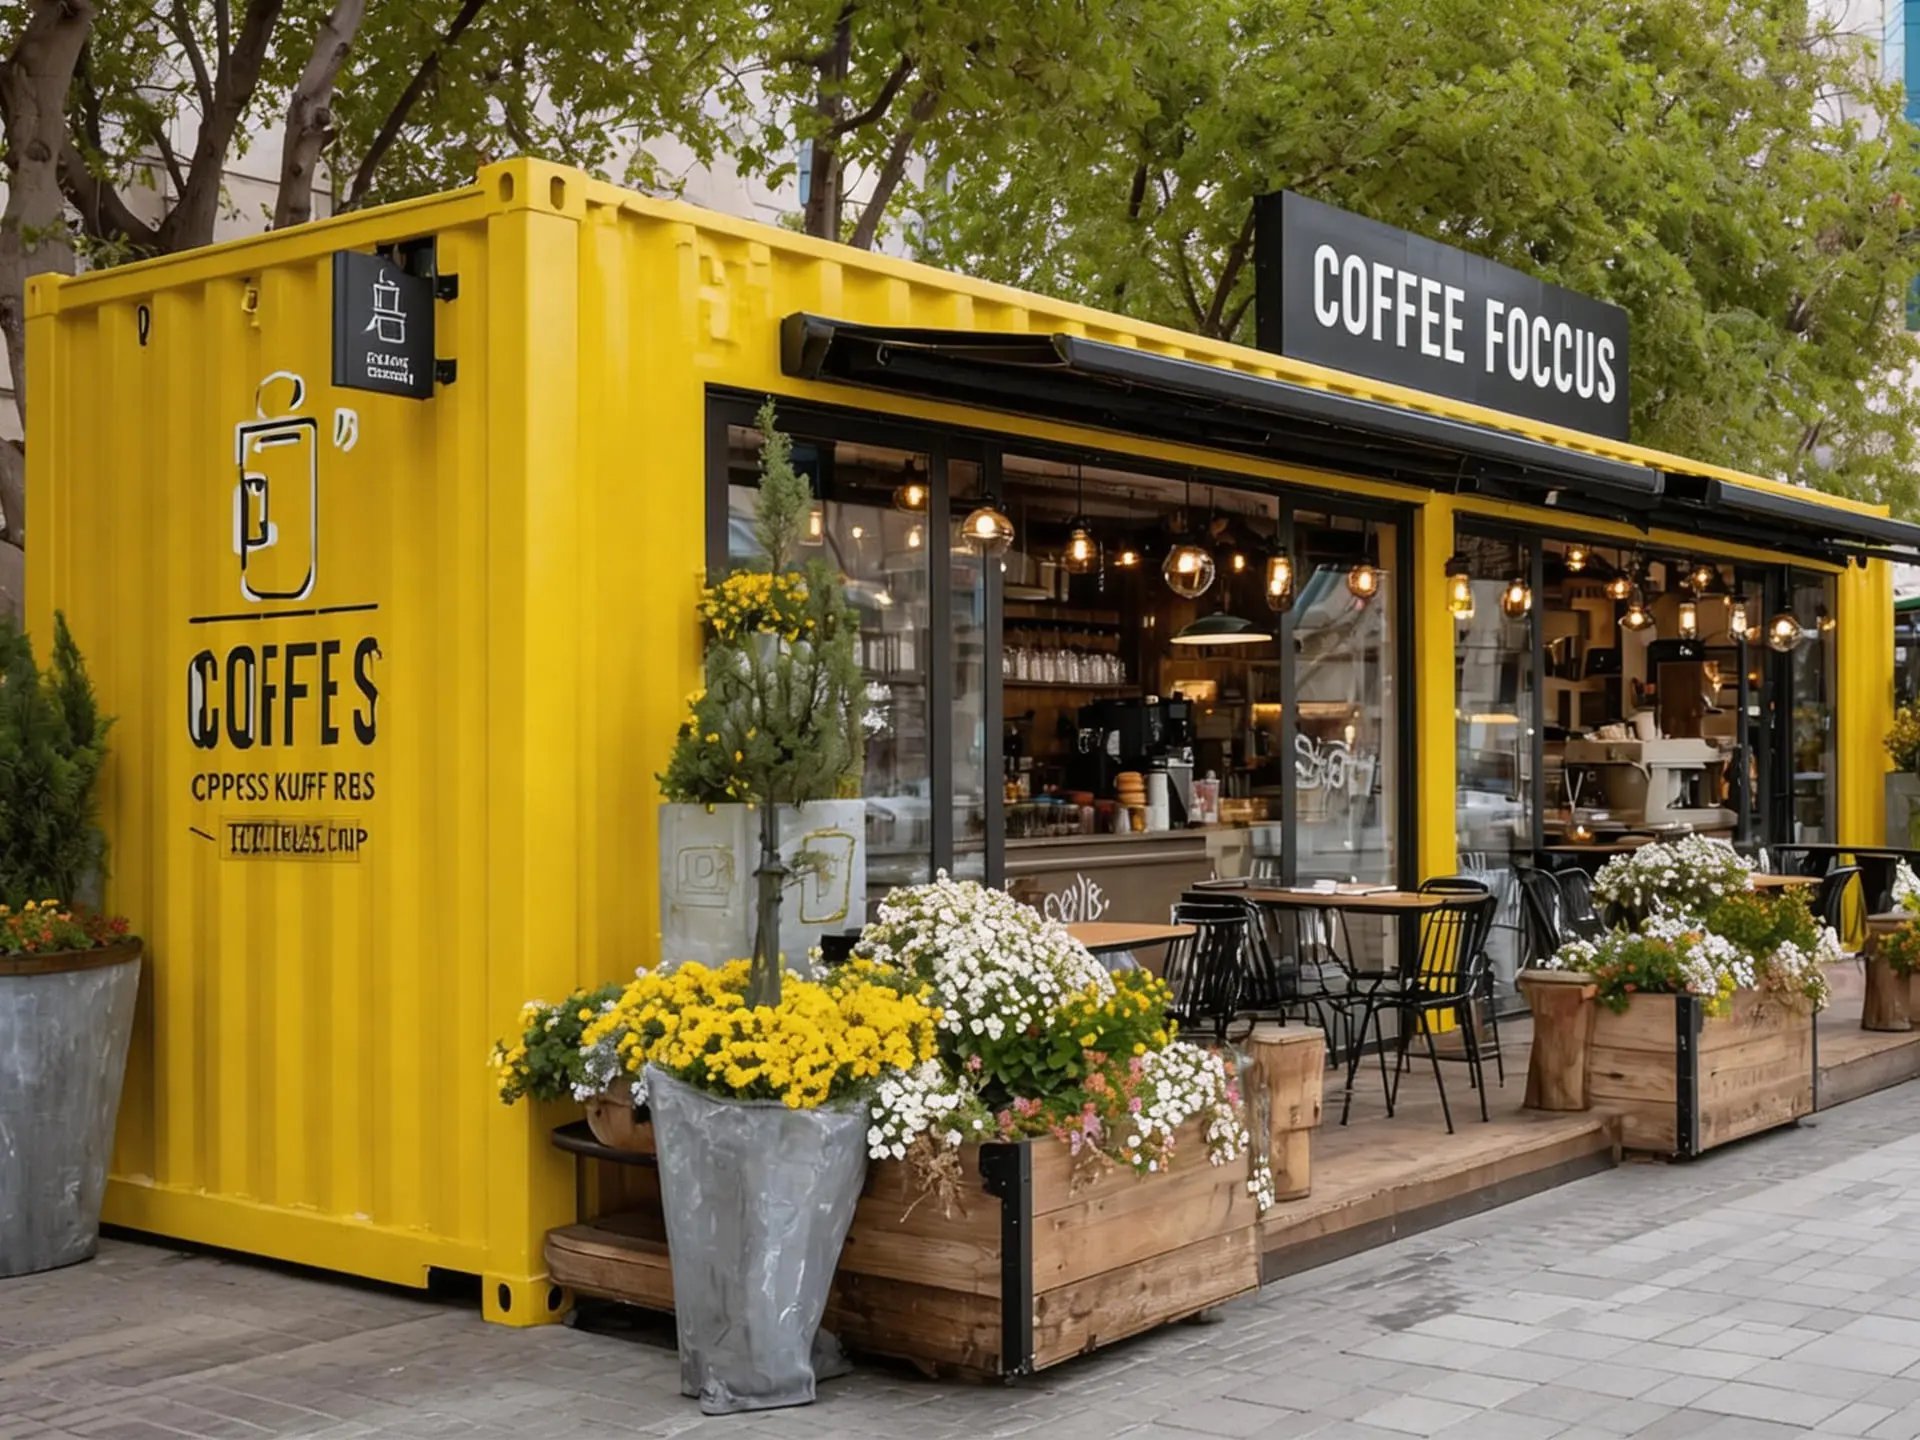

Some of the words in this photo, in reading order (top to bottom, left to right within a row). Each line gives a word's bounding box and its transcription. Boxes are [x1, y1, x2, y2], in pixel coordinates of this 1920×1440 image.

[1313, 244, 1465, 364] COFFEE
[1485, 298, 1616, 404] FOCCUS
[187, 636, 383, 750] COFFES
